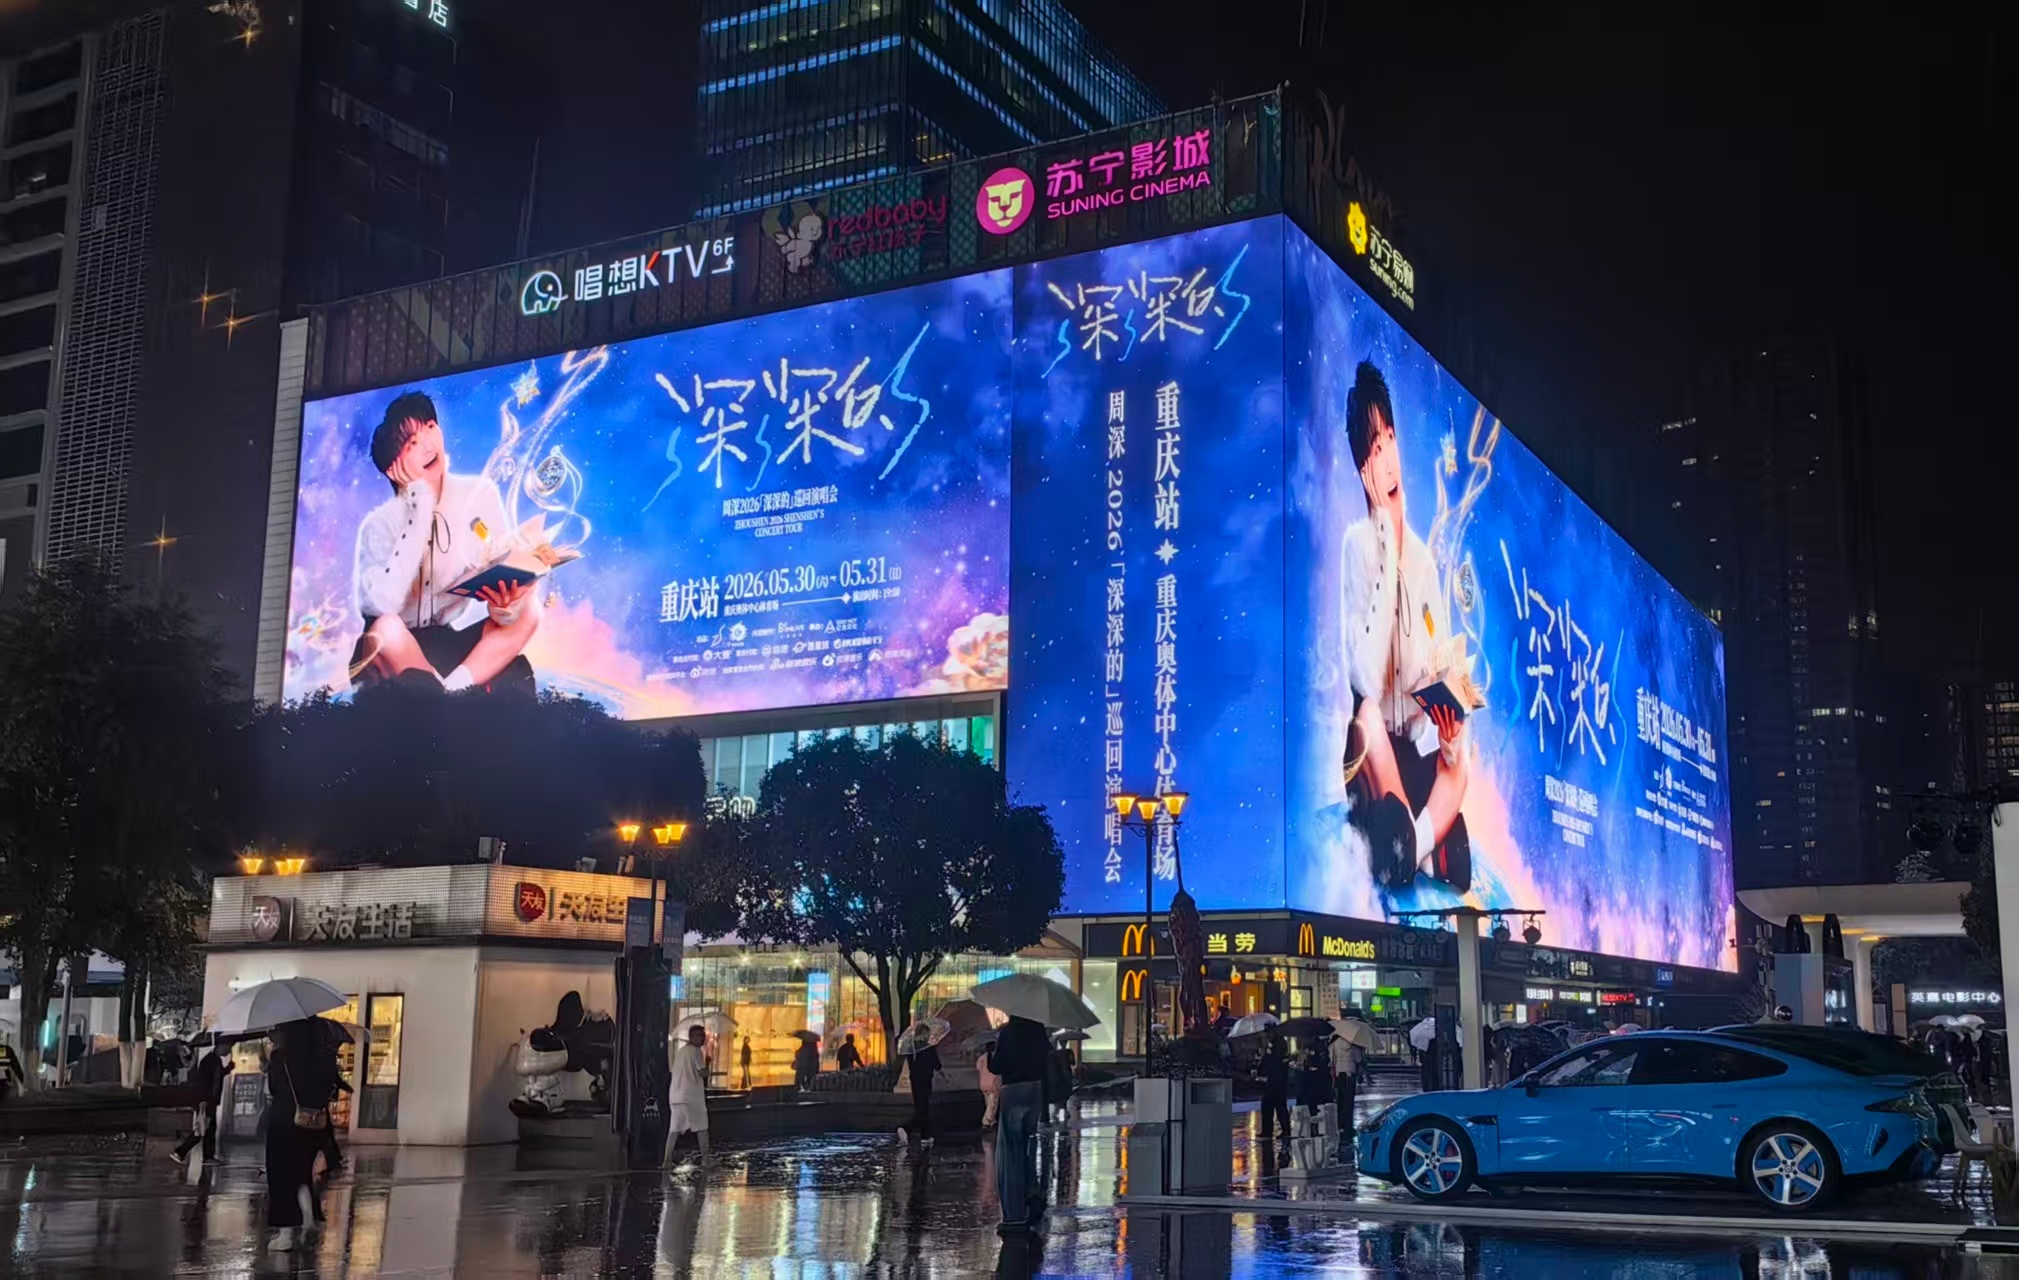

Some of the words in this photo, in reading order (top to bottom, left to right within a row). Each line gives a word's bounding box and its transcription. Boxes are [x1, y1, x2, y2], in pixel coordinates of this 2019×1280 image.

[1046, 129, 1210, 198] 苏宁影城
[827, 195, 947, 240] redbaby
[1047, 188, 1124, 219] SUNING
[1130, 171, 1211, 201] CINEMA
[574, 241, 709, 301] 唱想KTV
[713, 237, 735, 257] 6F
[1041, 244, 1250, 379] 深深的
[642, 321, 930, 512] 深深的
[1154, 381, 1181, 531] 重庆站
[659, 576, 720, 623] 重庆站
[560, 891, 625, 925] 天友生
[1208, 932, 1256, 953] 当劳
[1323, 936, 1375, 959] McDonald's
